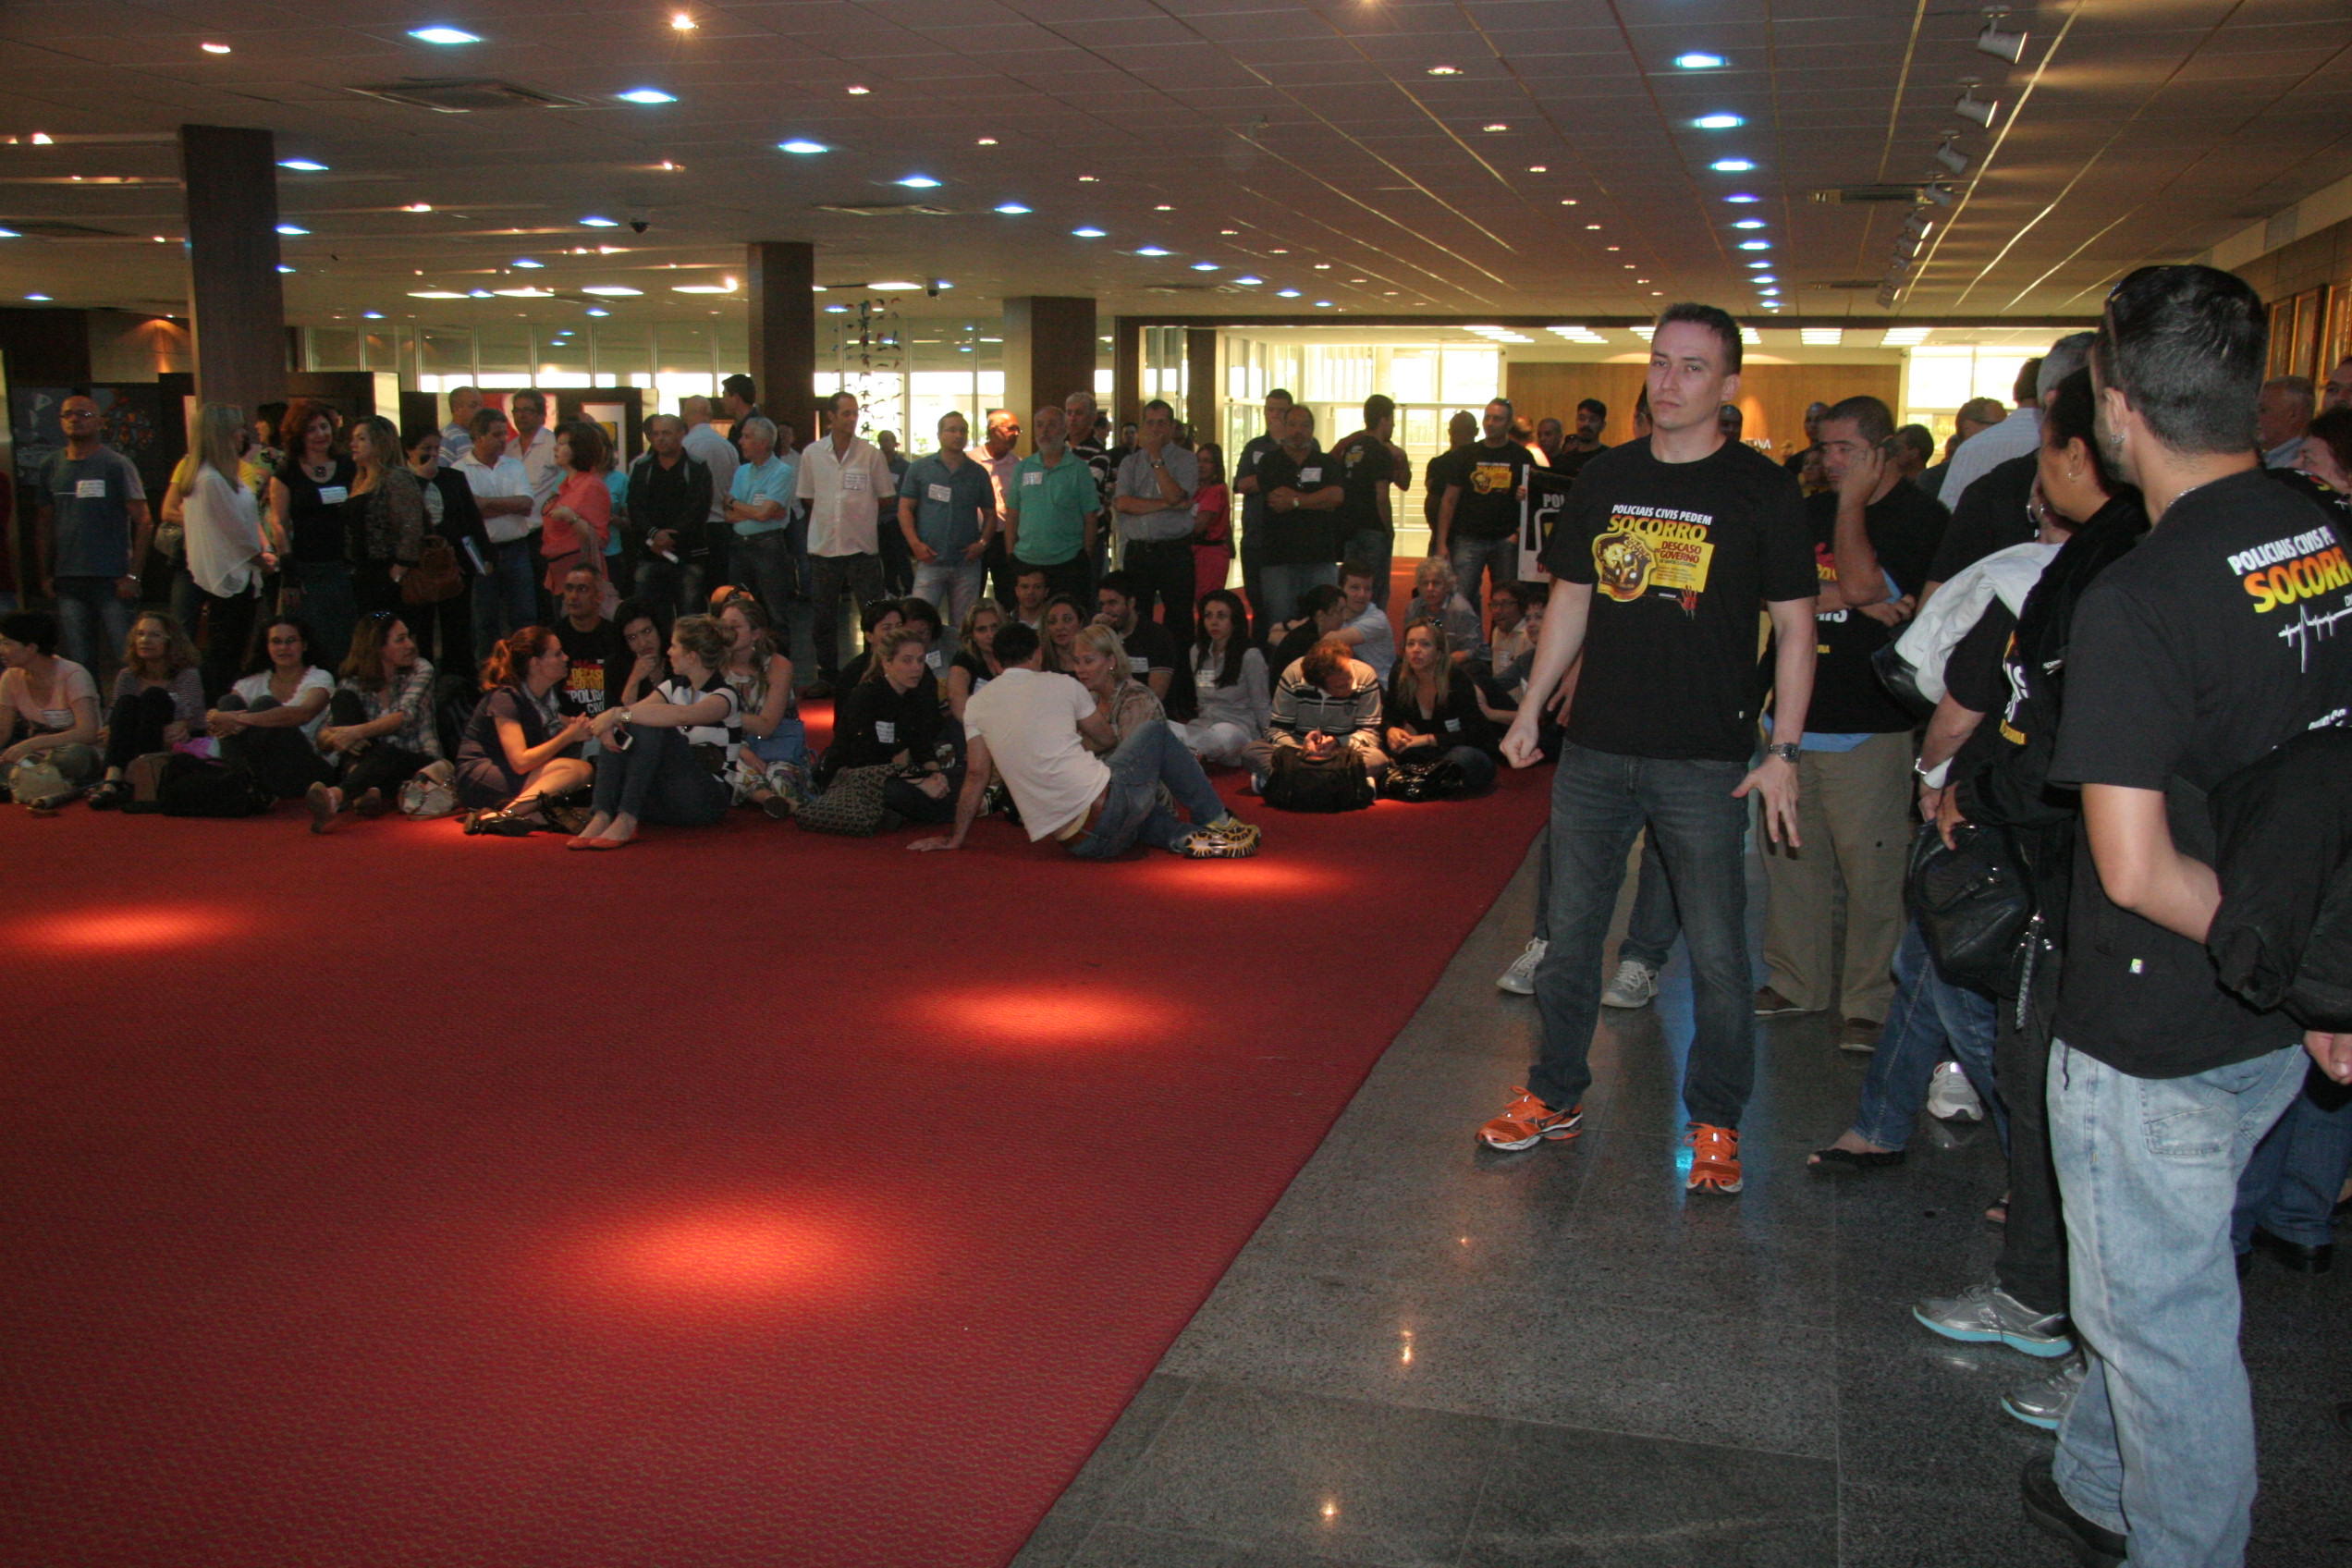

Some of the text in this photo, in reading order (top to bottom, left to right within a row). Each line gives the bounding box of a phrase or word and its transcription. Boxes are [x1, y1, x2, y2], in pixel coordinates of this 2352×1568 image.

[1611, 504, 1713, 526] POLICIAIS CIVIS PEDEM
[1607, 514, 1708, 543] SOCORRO
[1660, 550, 1700, 564] GOVERNO
[1661, 541, 1702, 555] DESCASO
[2226, 536, 2298, 576] POLICIAIS
[2293, 528, 2325, 556] CIVIS
